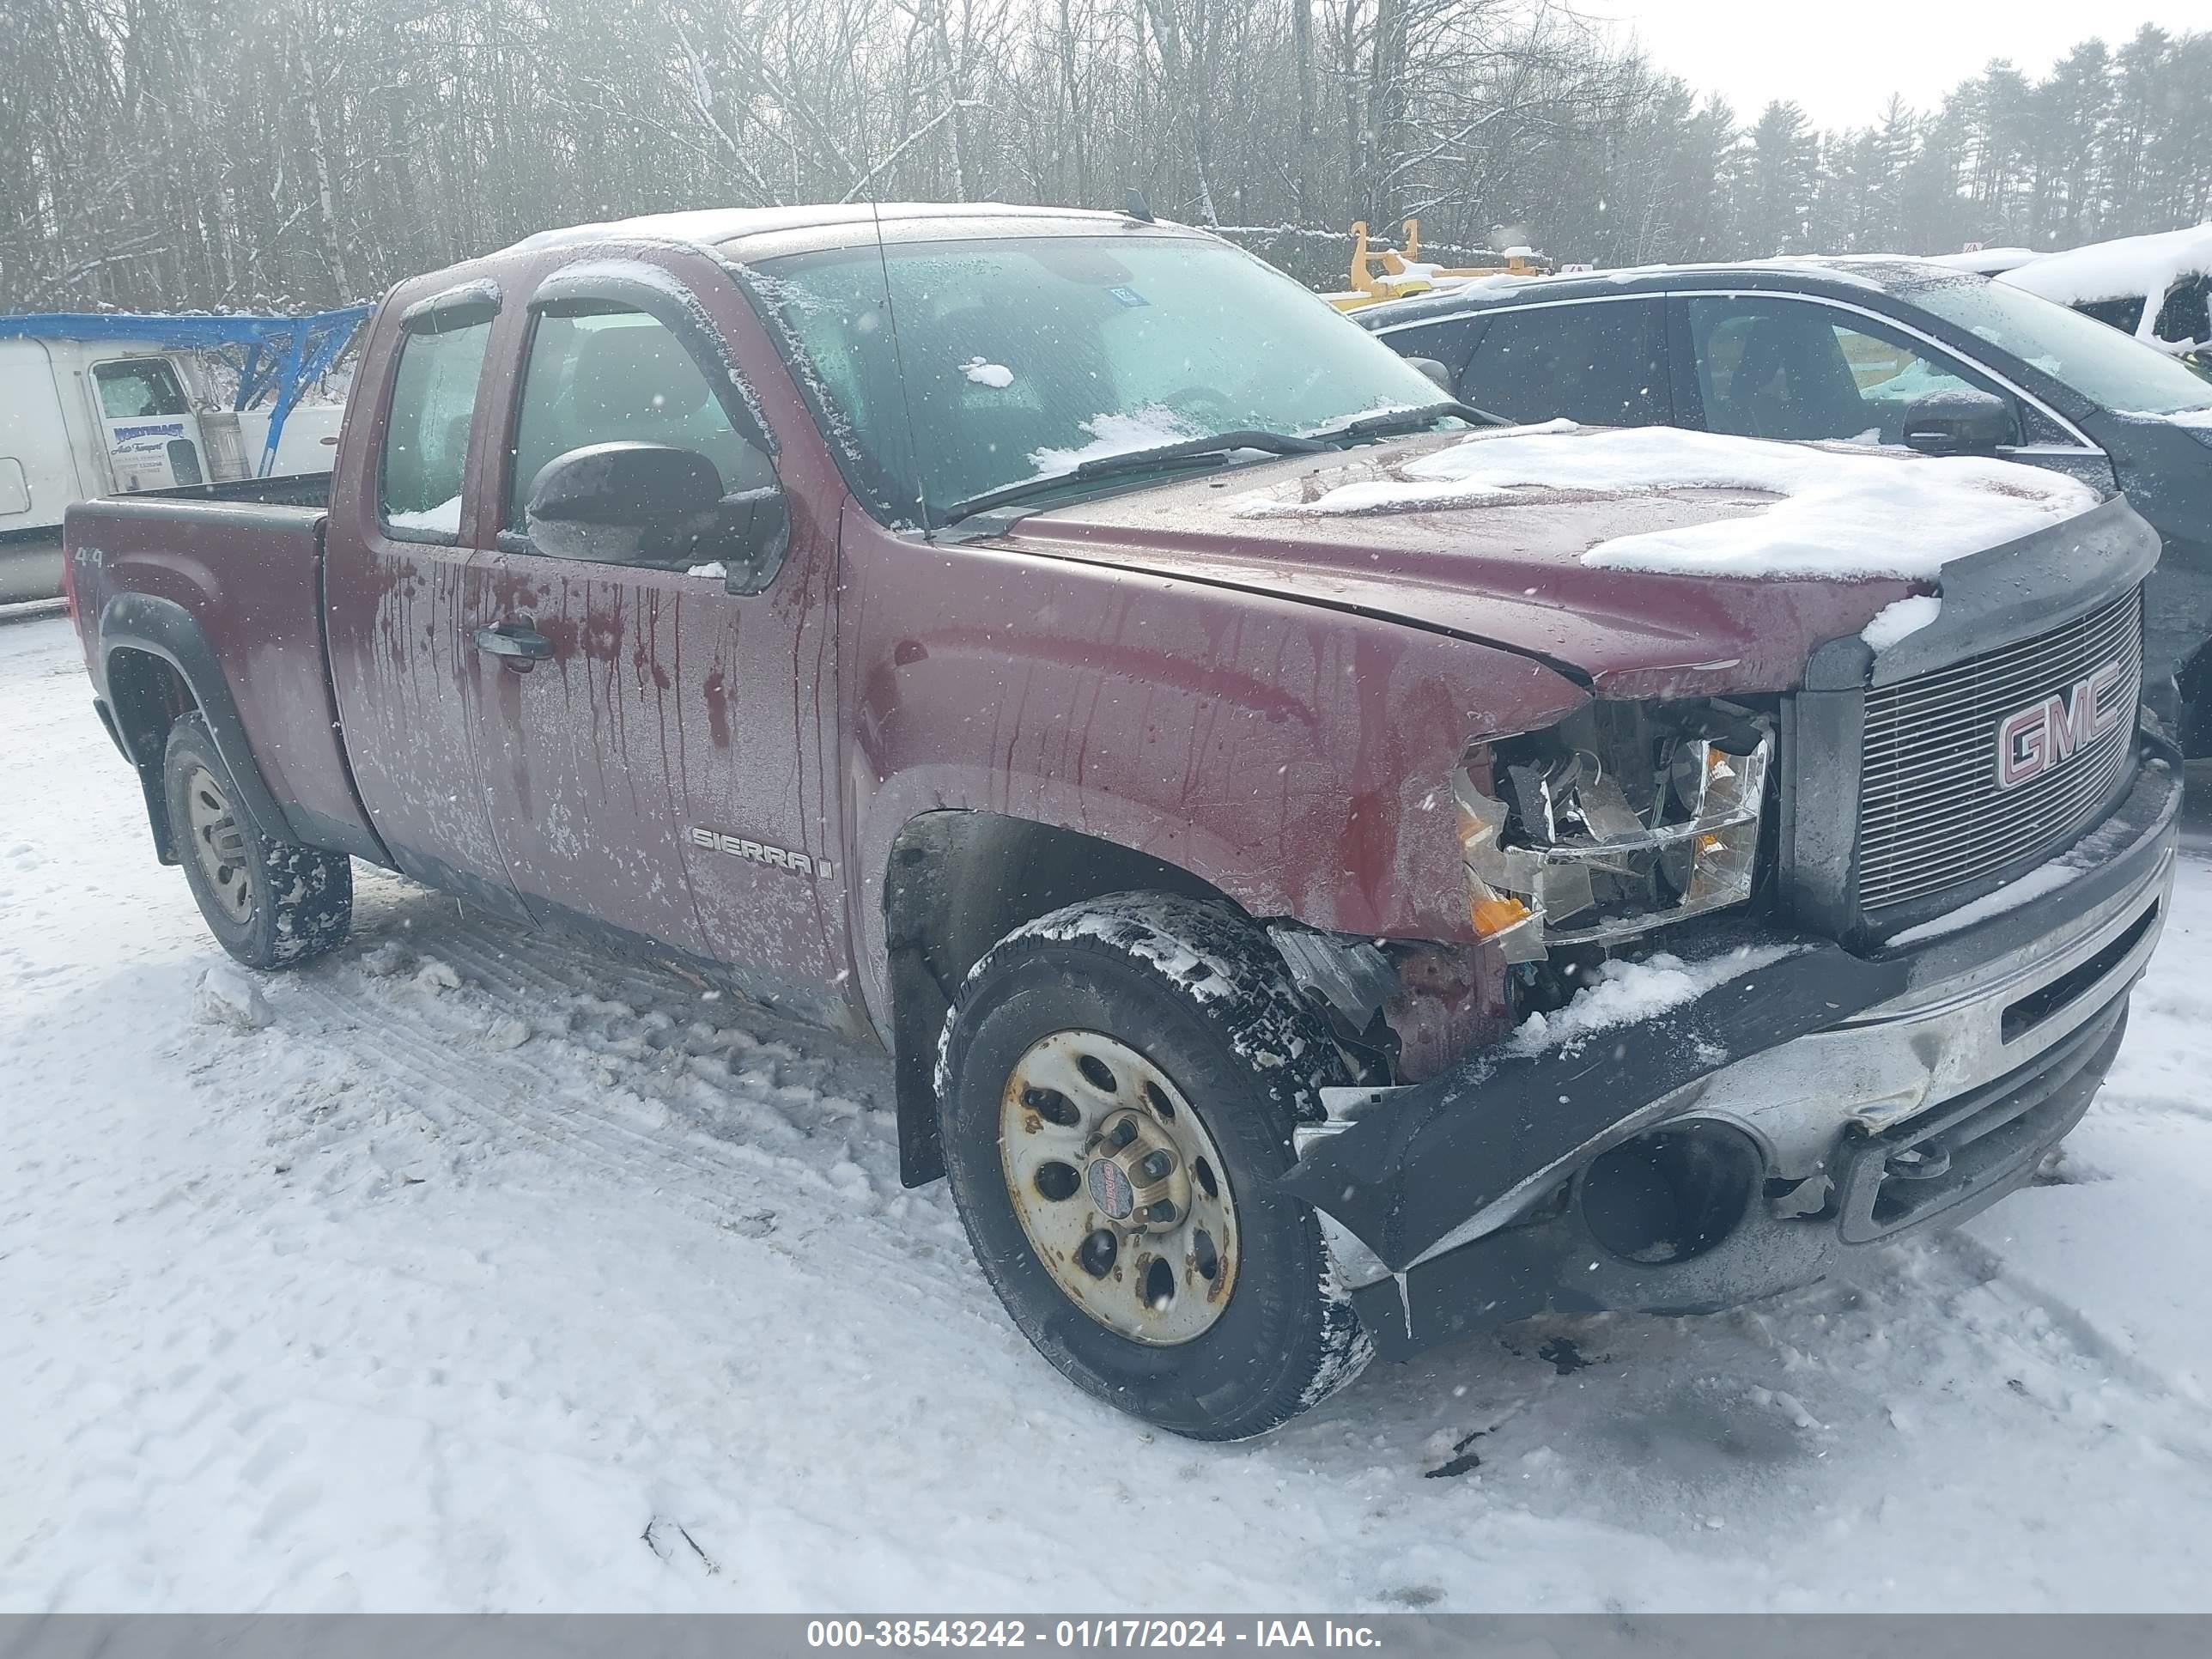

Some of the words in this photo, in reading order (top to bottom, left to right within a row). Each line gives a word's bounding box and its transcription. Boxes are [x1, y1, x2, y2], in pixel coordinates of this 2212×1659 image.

[110, 445, 132, 455] Auto
[132, 442, 164, 453] Transport
[113, 423, 185, 444] NORTHEAST
[1998, 659, 2119, 791] GMC
[691, 827, 813, 875] SIERRA
[1103, 1163, 1118, 1218] GMC
